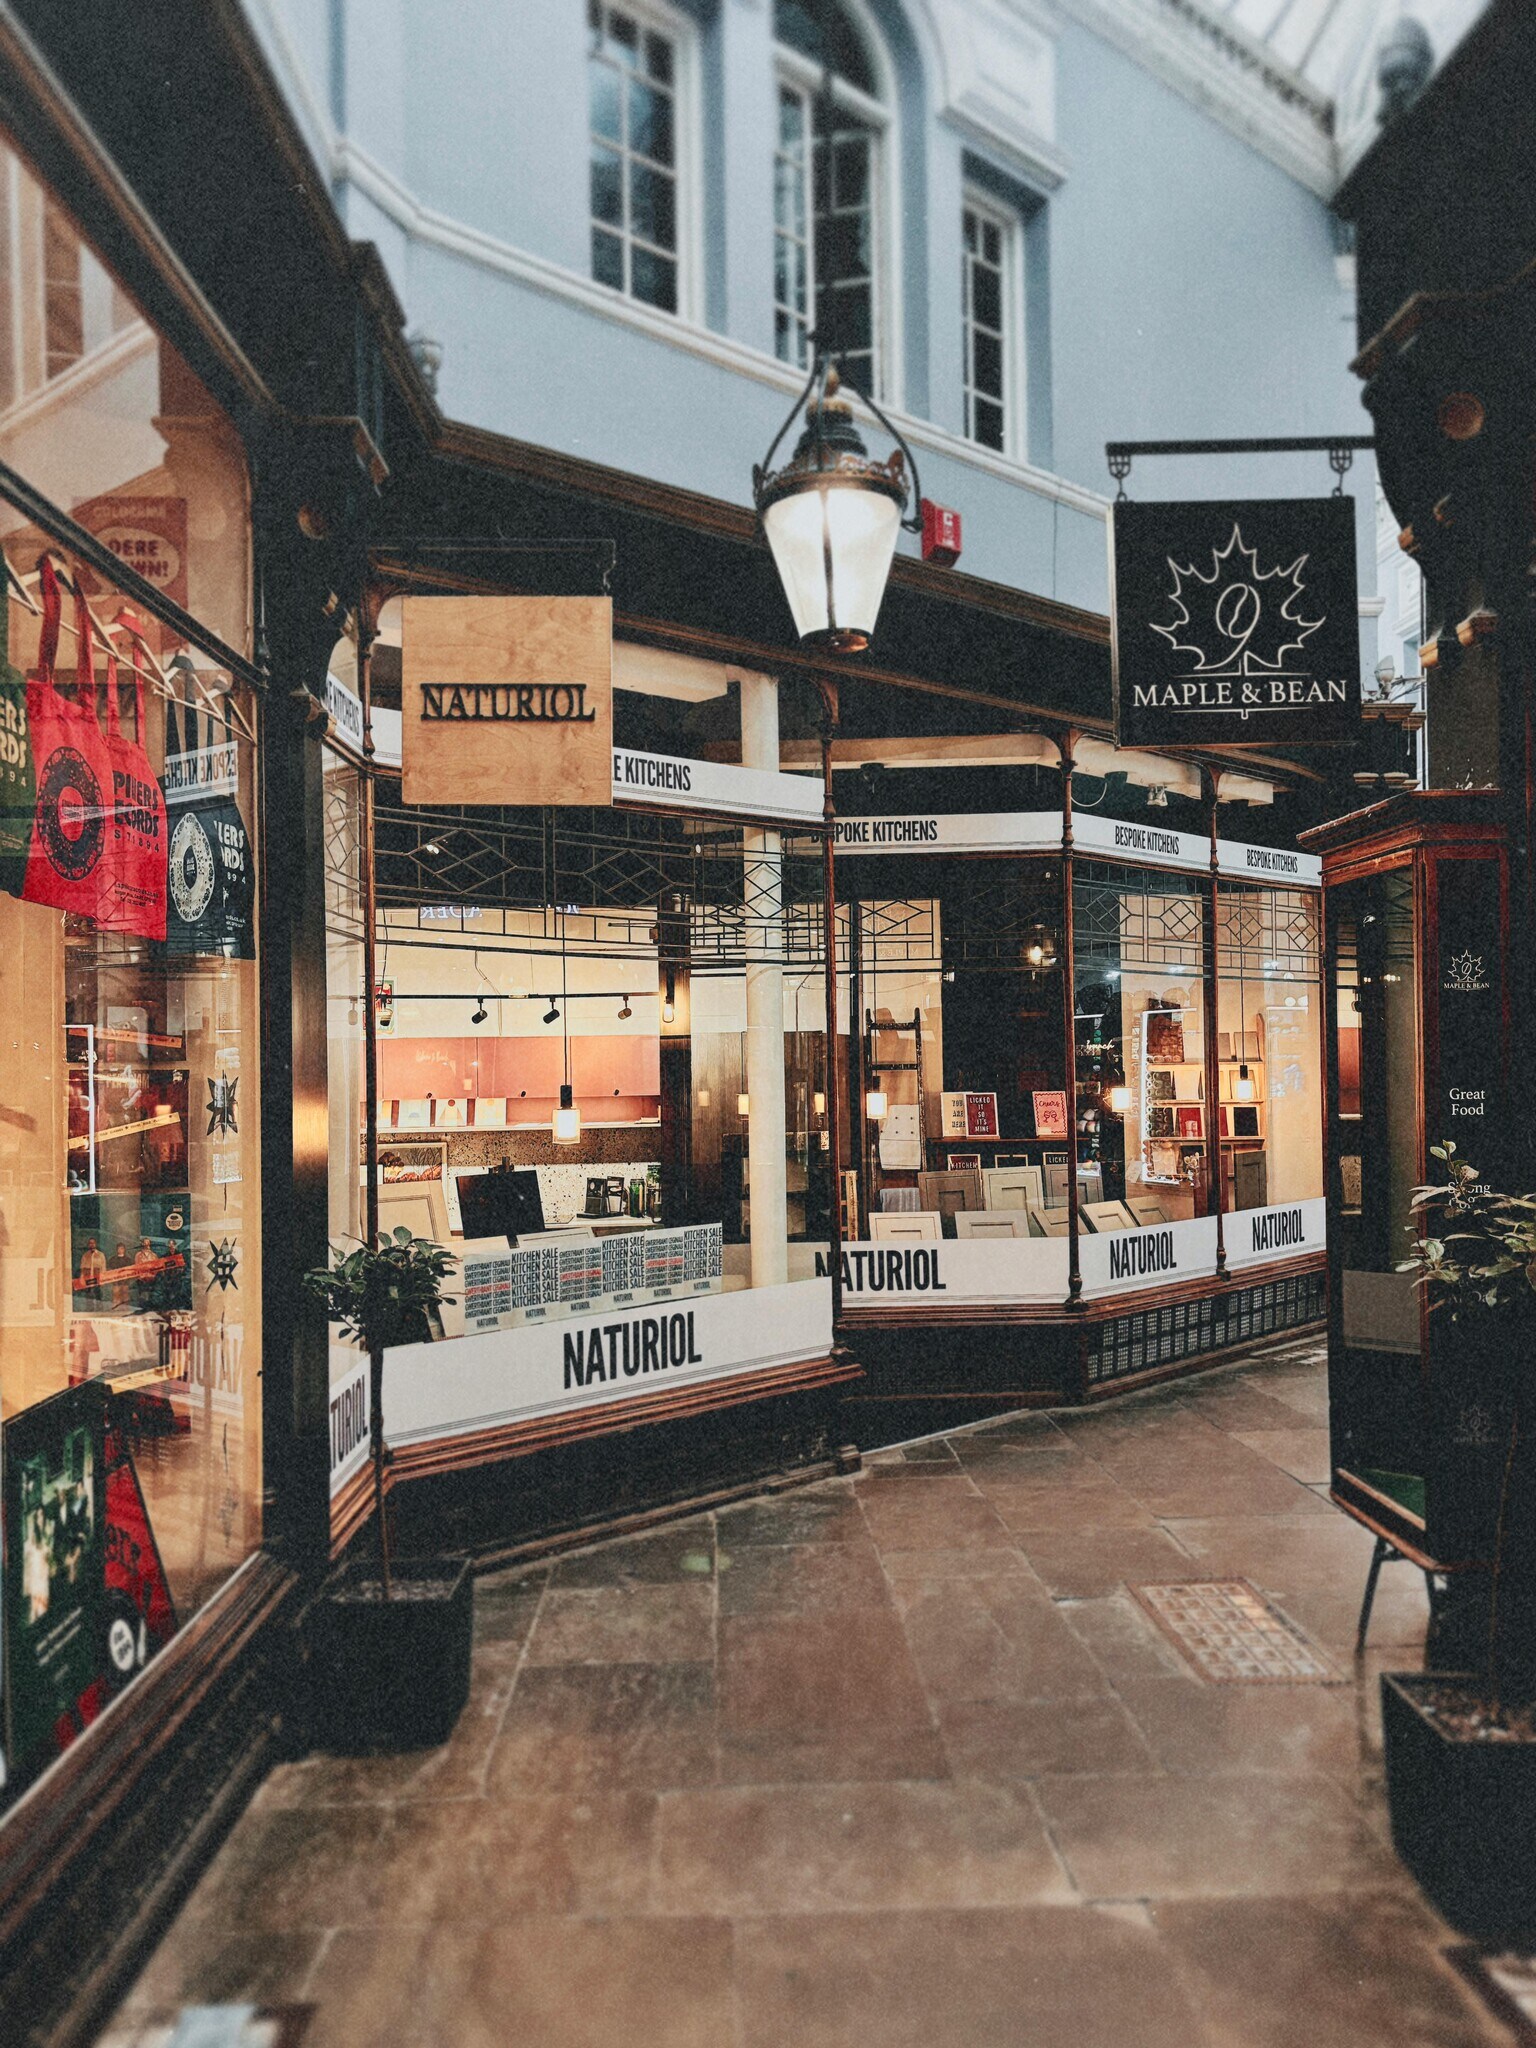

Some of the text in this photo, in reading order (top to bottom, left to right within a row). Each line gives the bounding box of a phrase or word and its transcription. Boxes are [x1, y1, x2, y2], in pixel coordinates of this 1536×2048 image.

[1133, 680, 1347, 706] MAPLE & BEAN
[420, 683, 595, 721] NATURIOL
[625, 756, 691, 791] KITCHENS
[873, 820, 938, 842] KITCHENS
[1115, 825, 1180, 855] BESPOKE KITCHENS
[1246, 849, 1298, 874] BESPOKE KITCHENS
[1449, 1088, 1485, 1100] Great
[1451, 1103, 1484, 1116] Food
[684, 1227, 722, 1240] KITCHEN SALE
[1252, 1209, 1305, 1252] NATURIOL
[602, 1236, 644, 1250] KITCHEN SALE
[684, 1237, 722, 1250] KITCHEN SALE
[512, 1248, 558, 1264] KITCHEN SALE
[602, 1246, 644, 1261] KITCHEN SALE
[684, 1247, 722, 1260] KITCHEN SALE
[1110, 1231, 1177, 1280] NATURIOL
[512, 1259, 558, 1275] KITCHEN SALE
[602, 1257, 644, 1272] KITCHEN SALE
[684, 1257, 722, 1270] KITCHEN SALE
[512, 1270, 558, 1286] KITCHEN SALE
[602, 1267, 644, 1282] KITCHEN SALE
[684, 1267, 721, 1281] KITCHEN SALE
[512, 1281, 559, 1297] KITCHEN SALE
[602, 1277, 644, 1293] KITCHEN SALE
[512, 1292, 559, 1308] KITCHEN SALE
[564, 1311, 702, 1390] NATURIOL
